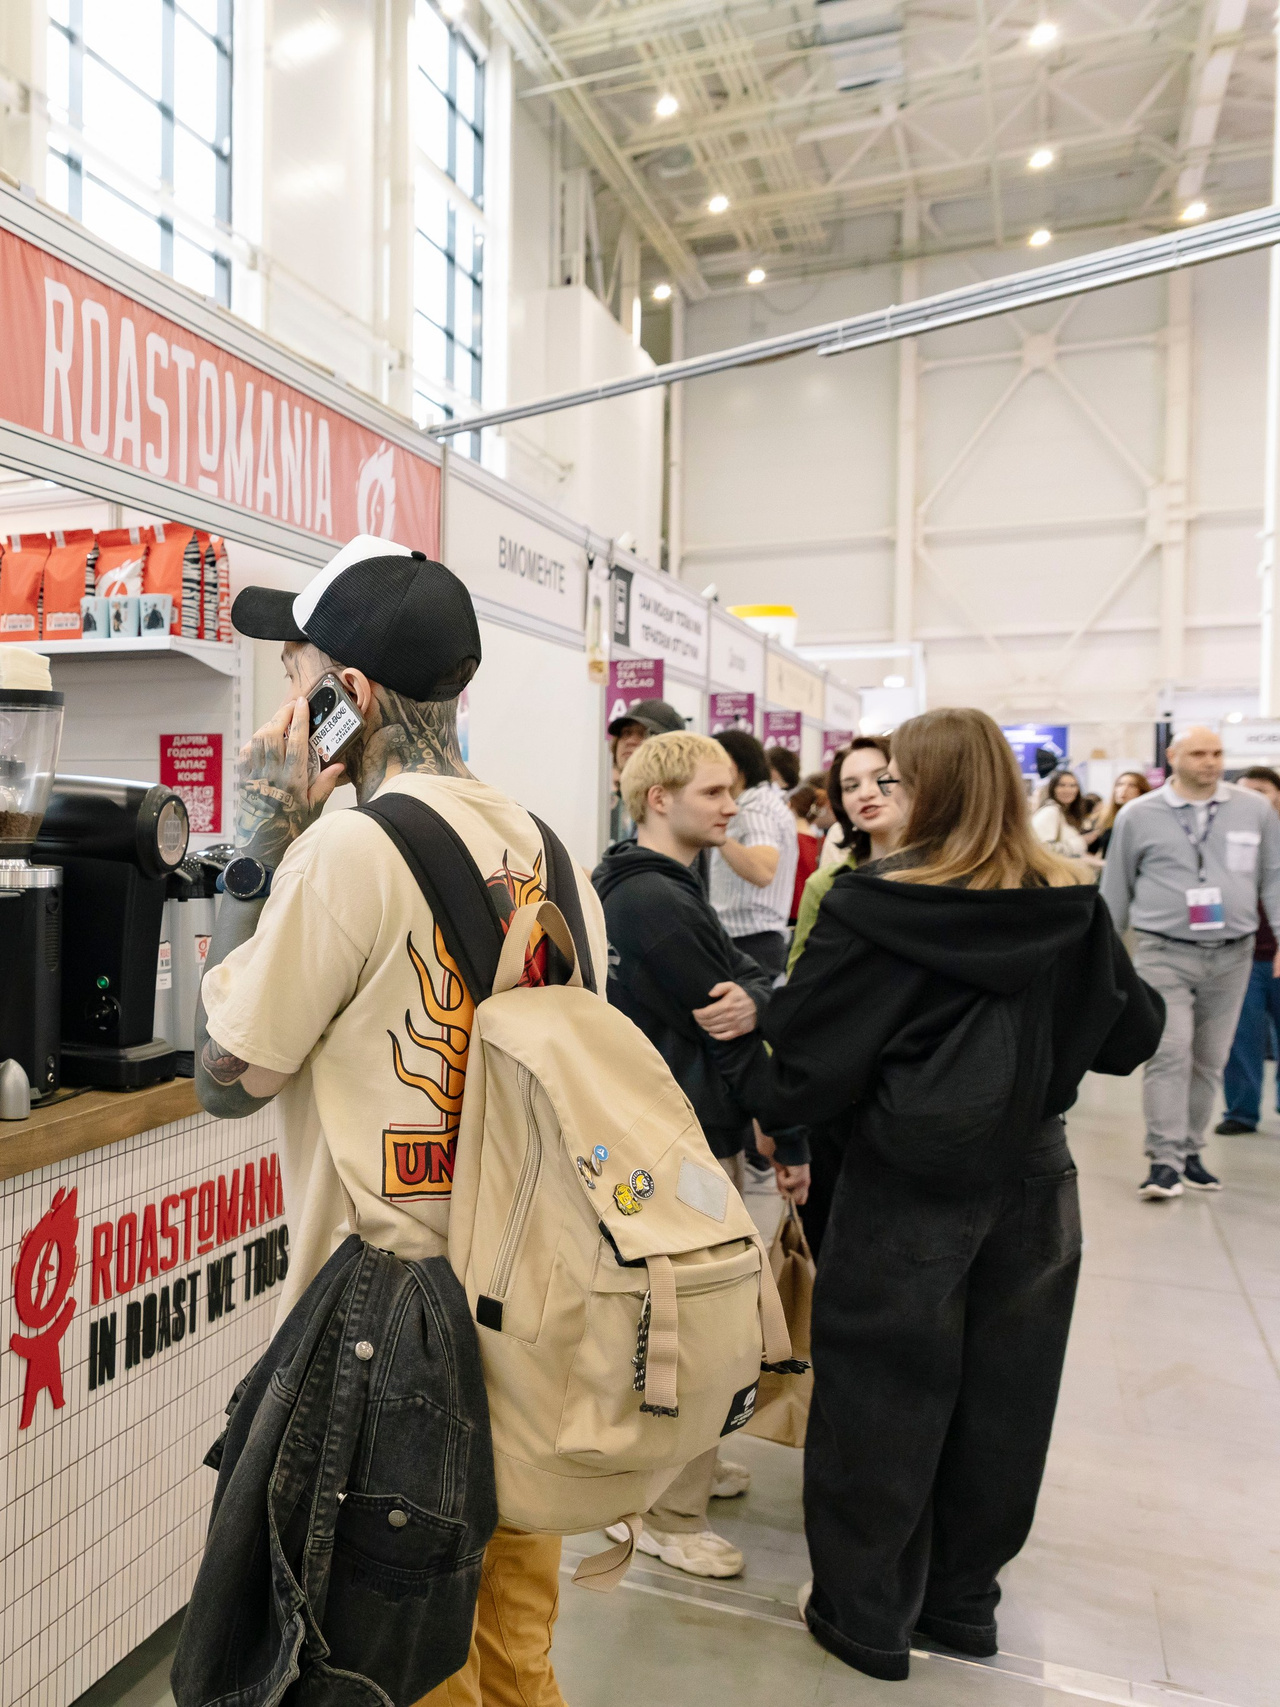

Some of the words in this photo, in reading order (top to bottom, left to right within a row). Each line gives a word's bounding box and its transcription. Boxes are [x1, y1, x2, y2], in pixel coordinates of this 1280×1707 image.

[43, 276, 333, 536] ROASTOMANIA
[499, 536, 565, 594] ВМОМЕНТЕ
[173, 735, 208, 747] ДАРИМ
[167, 746, 213, 759] ГОДОВОЙ
[174, 760, 207, 770] ЗАПАС
[178, 772, 205, 782] КОФЕ
[89, 1311, 118, 1391] IN
[125, 1269, 202, 1370] ROAST
[207, 1251, 237, 1323] WE
